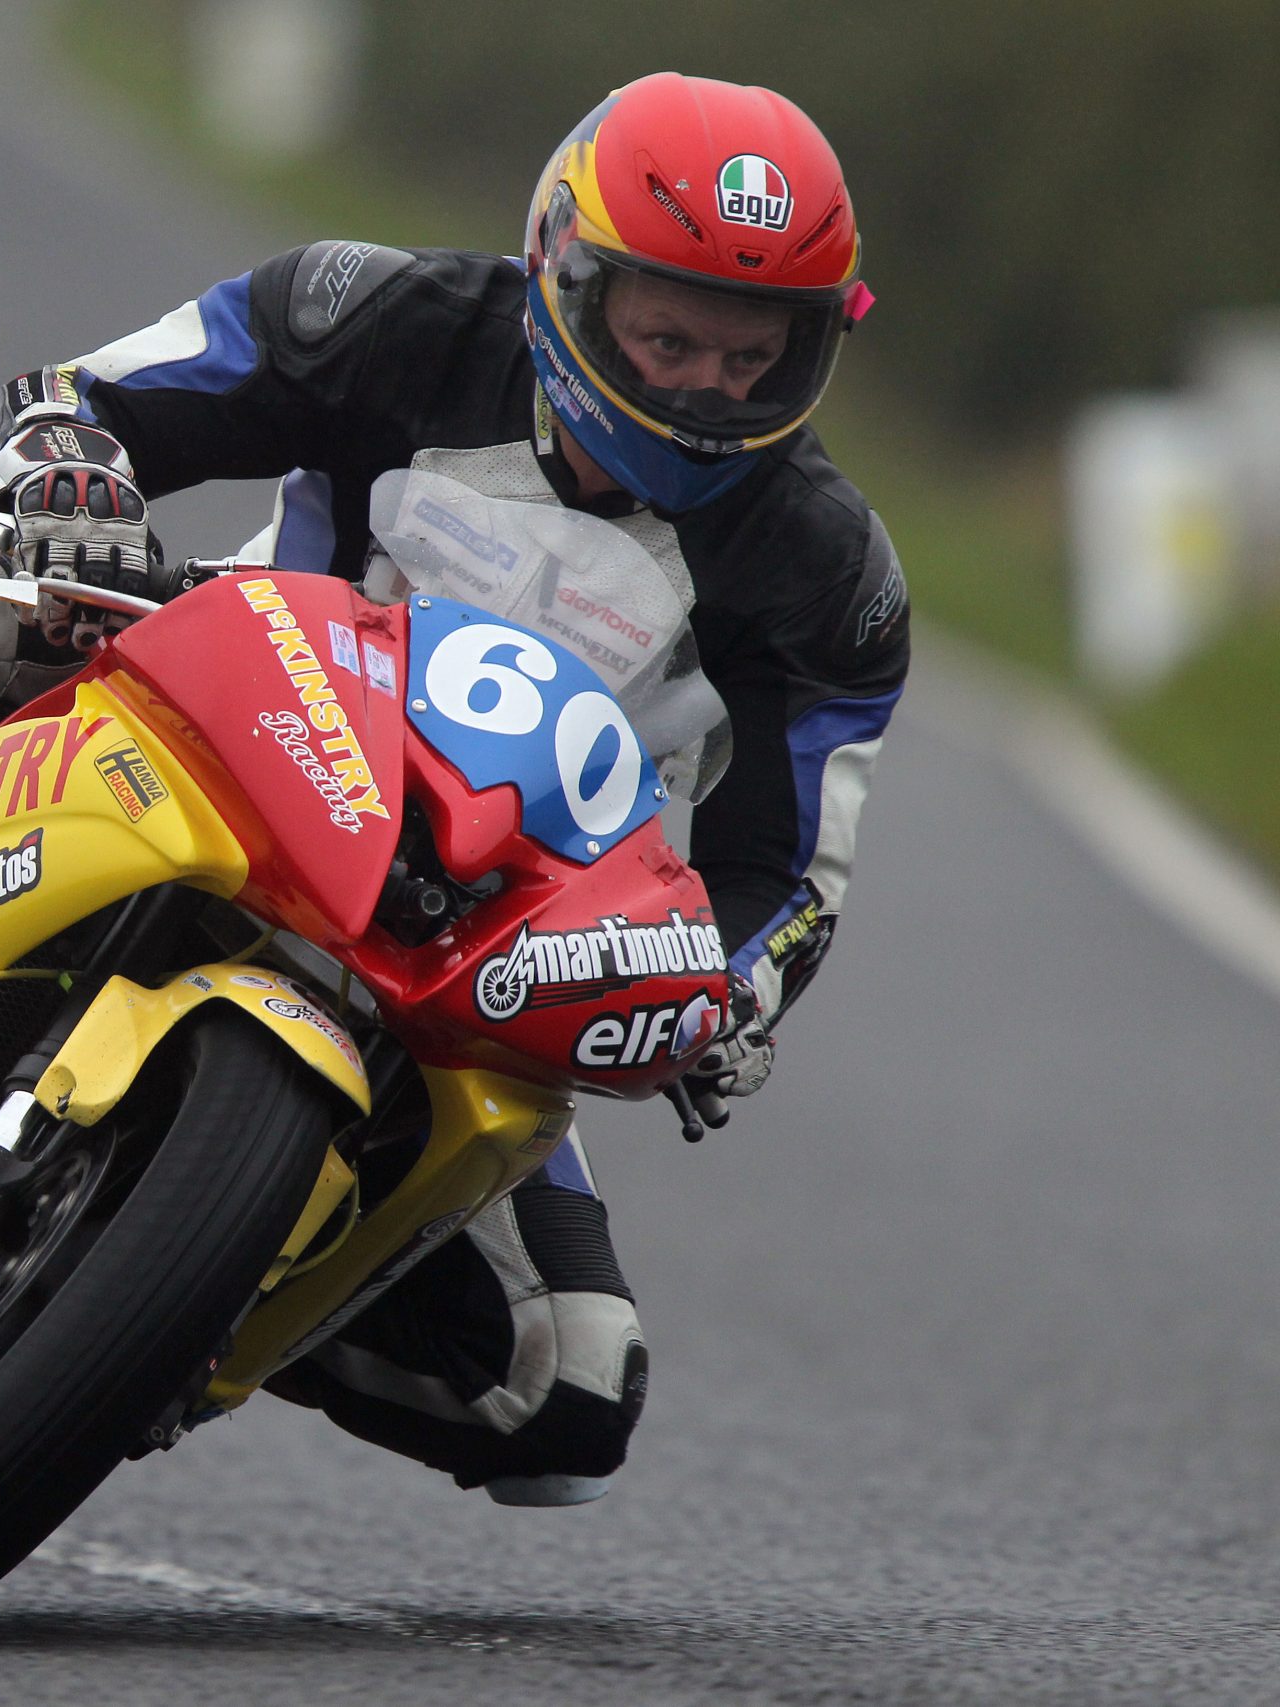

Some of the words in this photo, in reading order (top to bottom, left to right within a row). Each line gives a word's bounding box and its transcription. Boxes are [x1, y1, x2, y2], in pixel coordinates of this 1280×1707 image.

[727, 191, 784, 226] agv
[557, 585, 656, 649] daytona
[237, 577, 391, 820] McKINSTRY
[424, 623, 643, 836] 60
[107, 771, 144, 818] RACING
[258, 709, 364, 834] Racing
[531, 911, 728, 985] martimotos
[576, 1007, 676, 1067] elf
